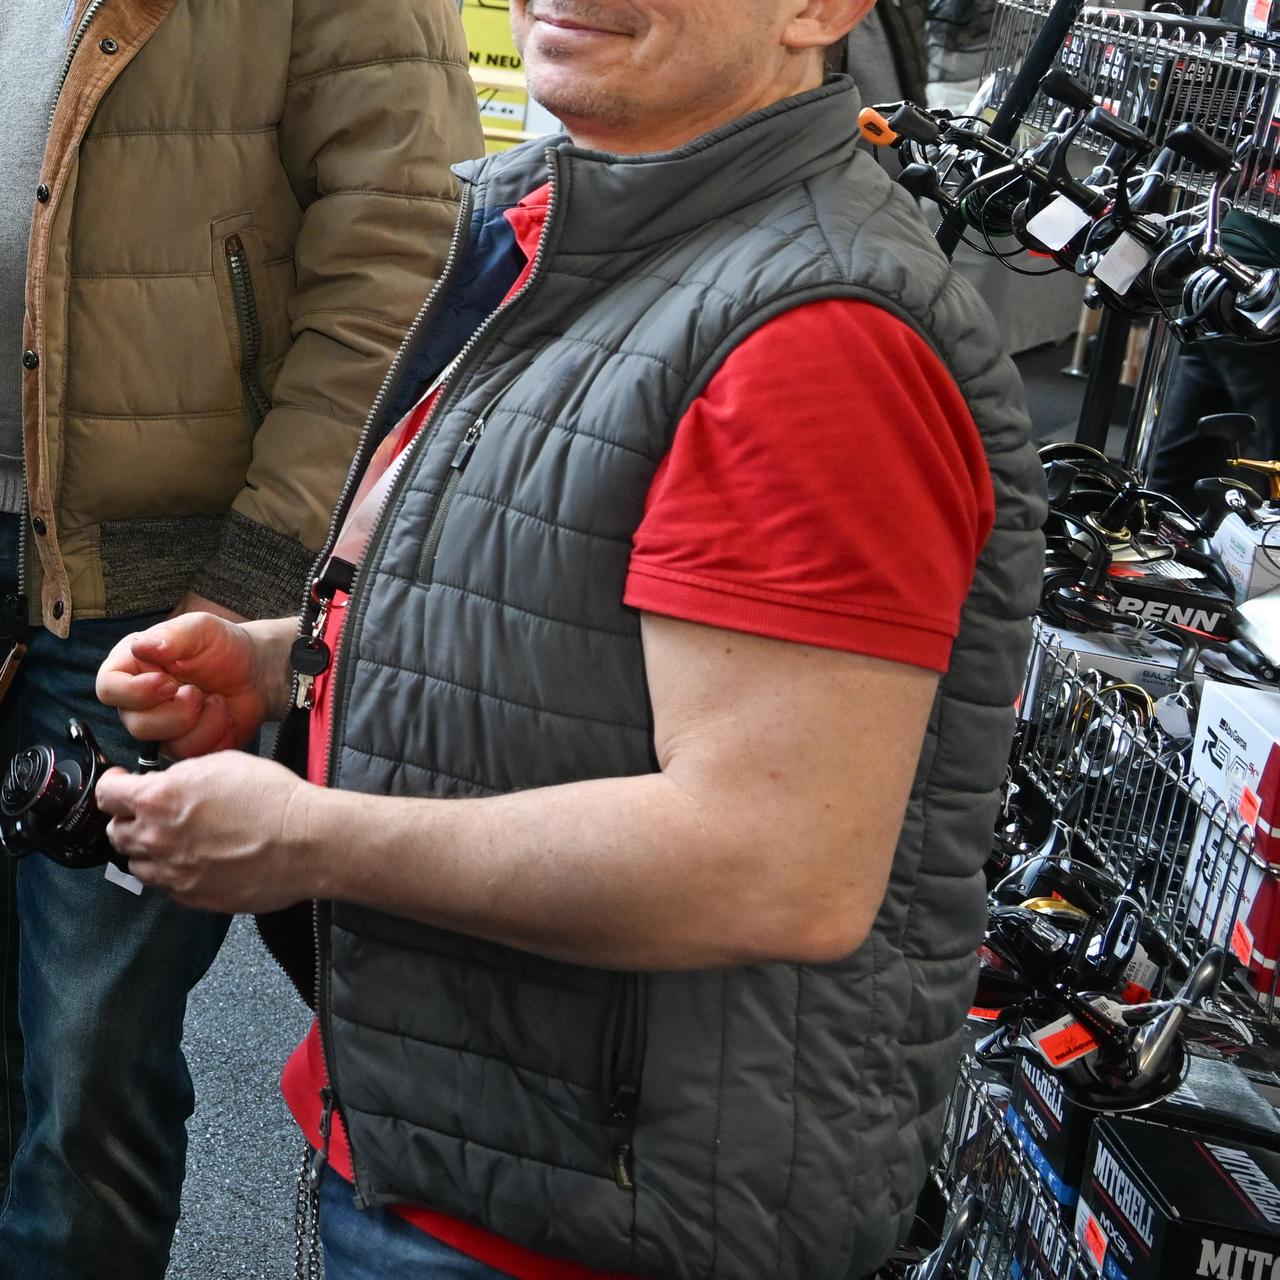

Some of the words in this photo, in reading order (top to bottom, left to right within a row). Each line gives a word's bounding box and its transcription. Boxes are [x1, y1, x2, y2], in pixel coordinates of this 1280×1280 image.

[1117, 595, 1222, 633] PENN
[1142, 668, 1176, 683] BALZ
[1092, 1138, 1156, 1250] MITCHELL
